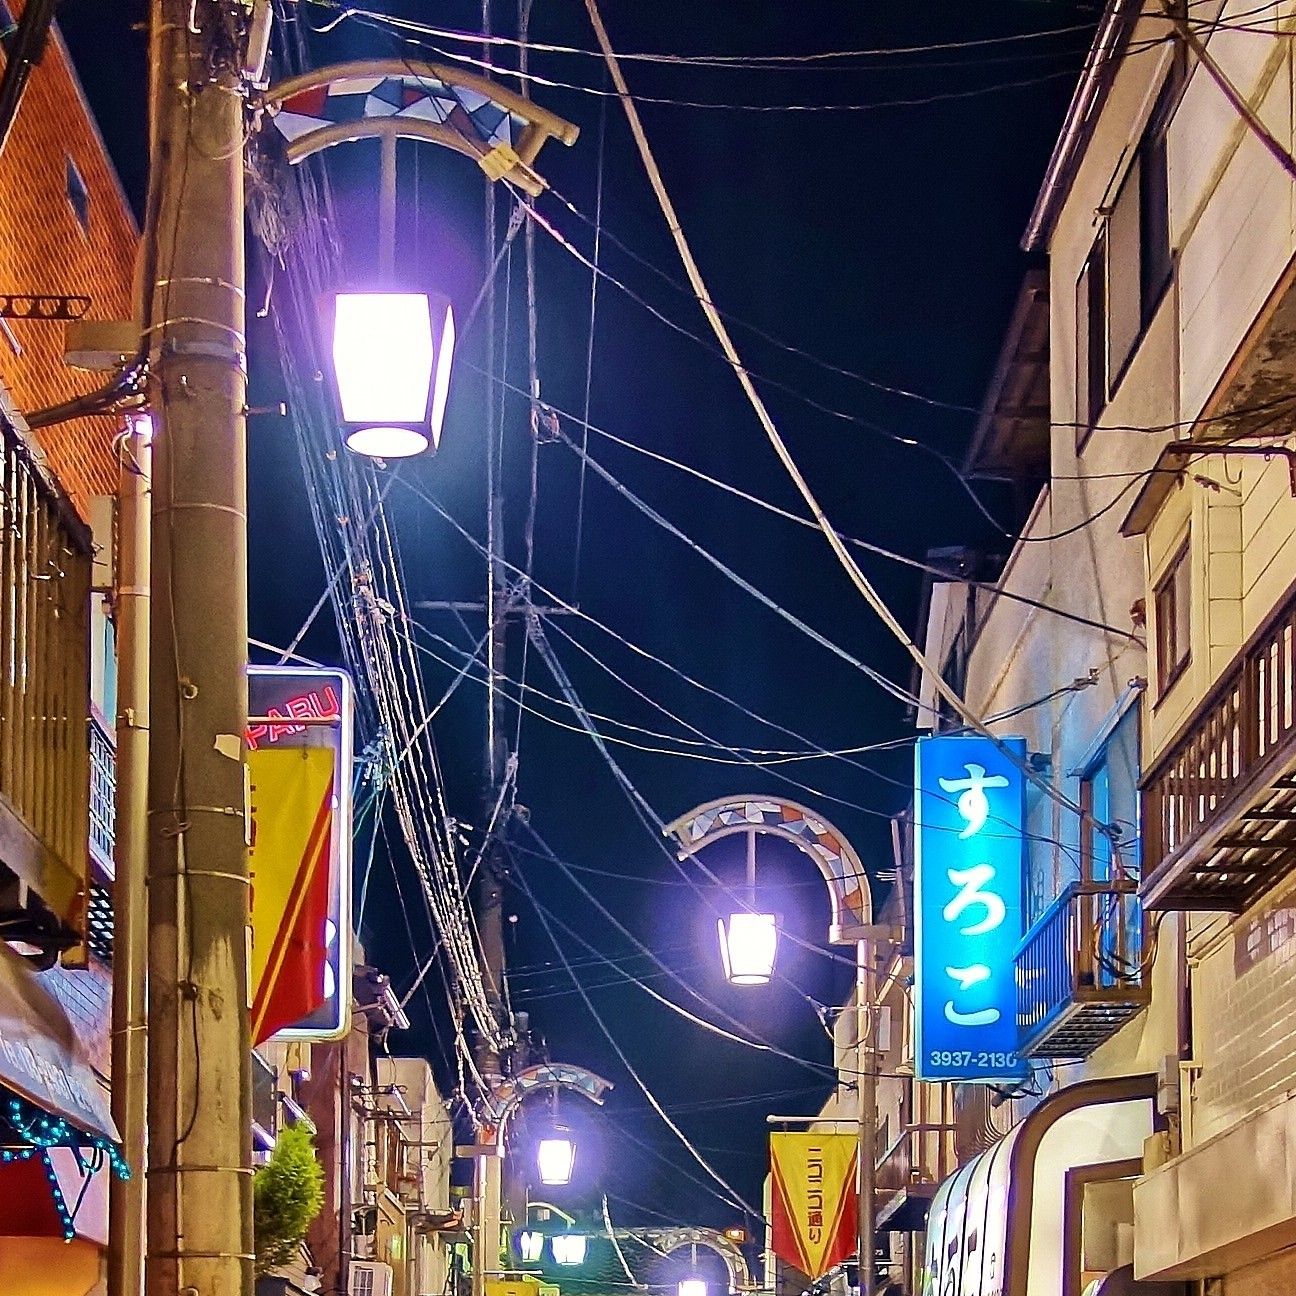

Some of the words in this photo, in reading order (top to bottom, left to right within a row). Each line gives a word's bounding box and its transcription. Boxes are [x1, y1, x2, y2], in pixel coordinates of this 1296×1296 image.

[938, 763, 1009, 1027] すろこ
[807, 1148, 823, 1244] ニコニコ通り
